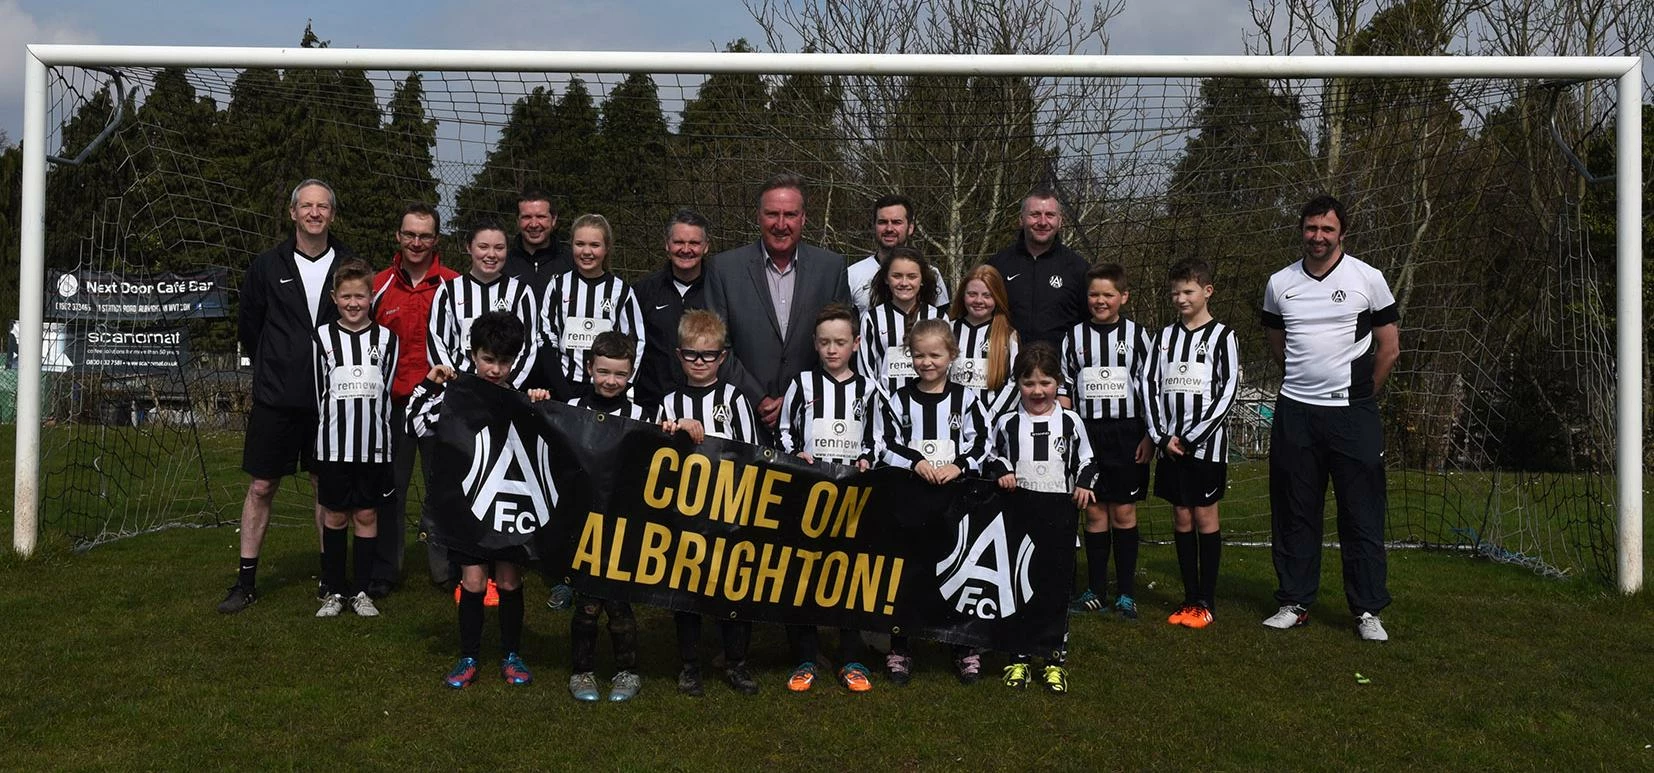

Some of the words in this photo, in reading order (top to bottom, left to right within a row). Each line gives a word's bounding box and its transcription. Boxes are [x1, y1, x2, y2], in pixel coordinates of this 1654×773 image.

[86, 281, 117, 293] Next
[121, 282, 154, 294] Door
[157, 281, 186, 293] Café
[189, 280, 214, 292] Bar
[87, 332, 180, 344] scanomat
[337, 382, 377, 391] rennew
[1086, 382, 1126, 391] rennew
[1165, 377, 1202, 386] rennew
[815, 438, 859, 449] rennew
[471, 420, 550, 528] A
[643, 447, 792, 530] COME
[801, 481, 872, 538] ON
[571, 511, 904, 615] ALBRIGHTON!
[939, 511, 1016, 618] A
